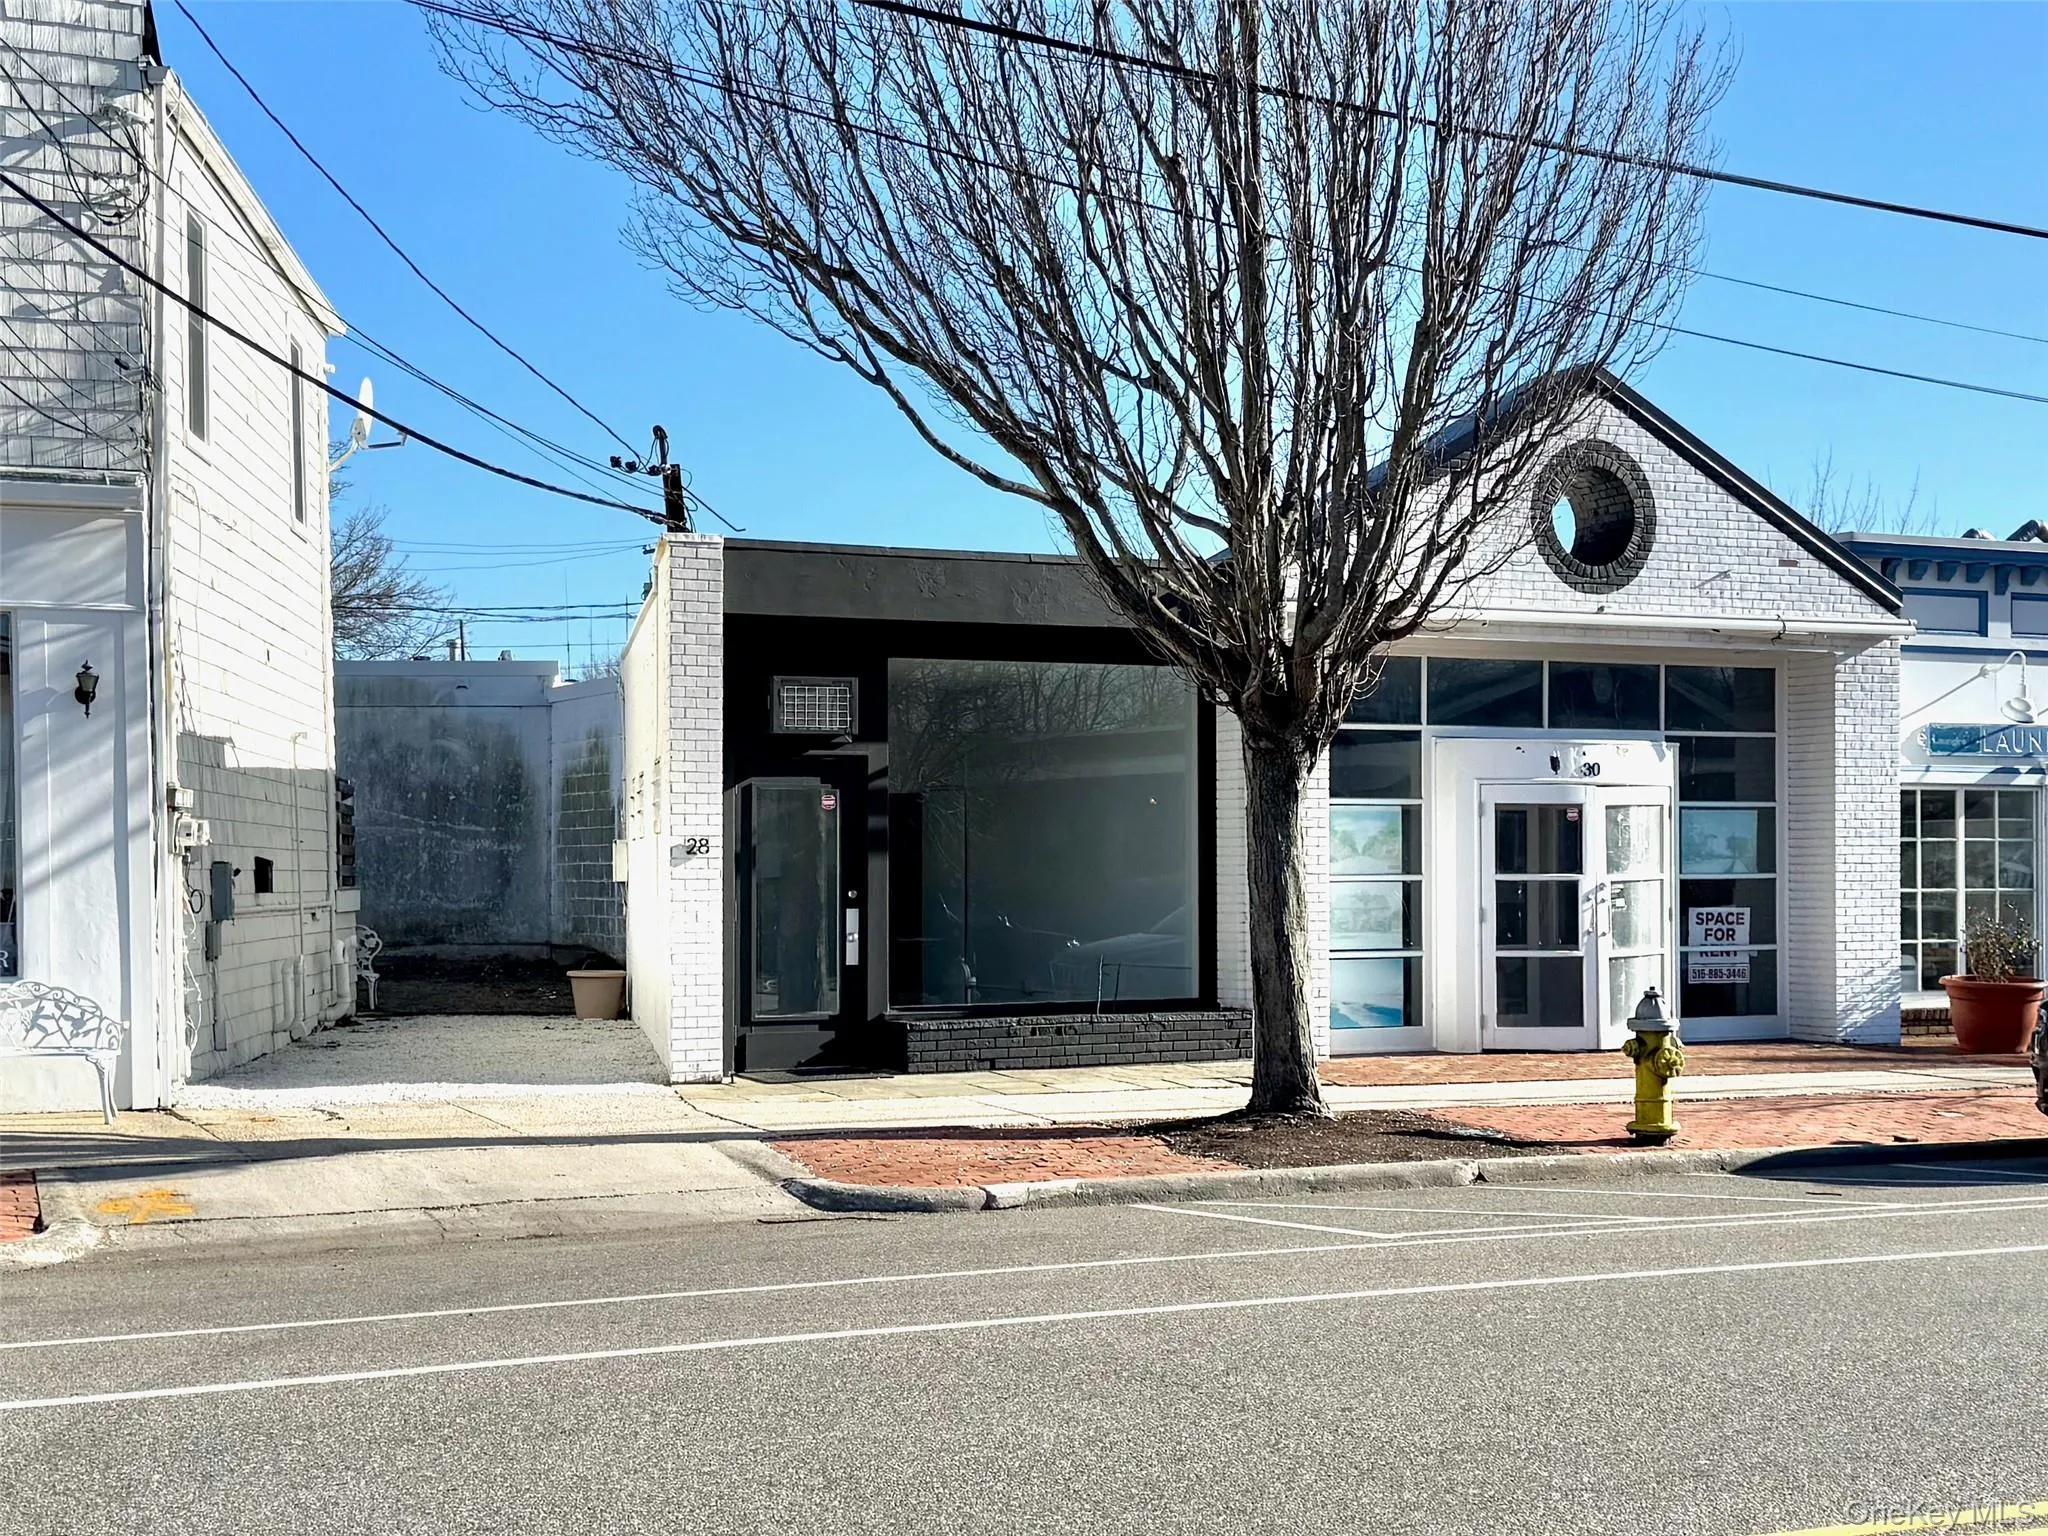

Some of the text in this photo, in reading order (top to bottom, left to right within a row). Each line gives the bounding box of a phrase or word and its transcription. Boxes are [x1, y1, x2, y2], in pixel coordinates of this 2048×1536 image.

[1983, 728, 2048, 753] LAUN
[1582, 762, 1601, 777] 30
[686, 838, 710, 855] 28
[1695, 912, 1745, 926] SPACE
[1704, 928, 1736, 941] FOR
